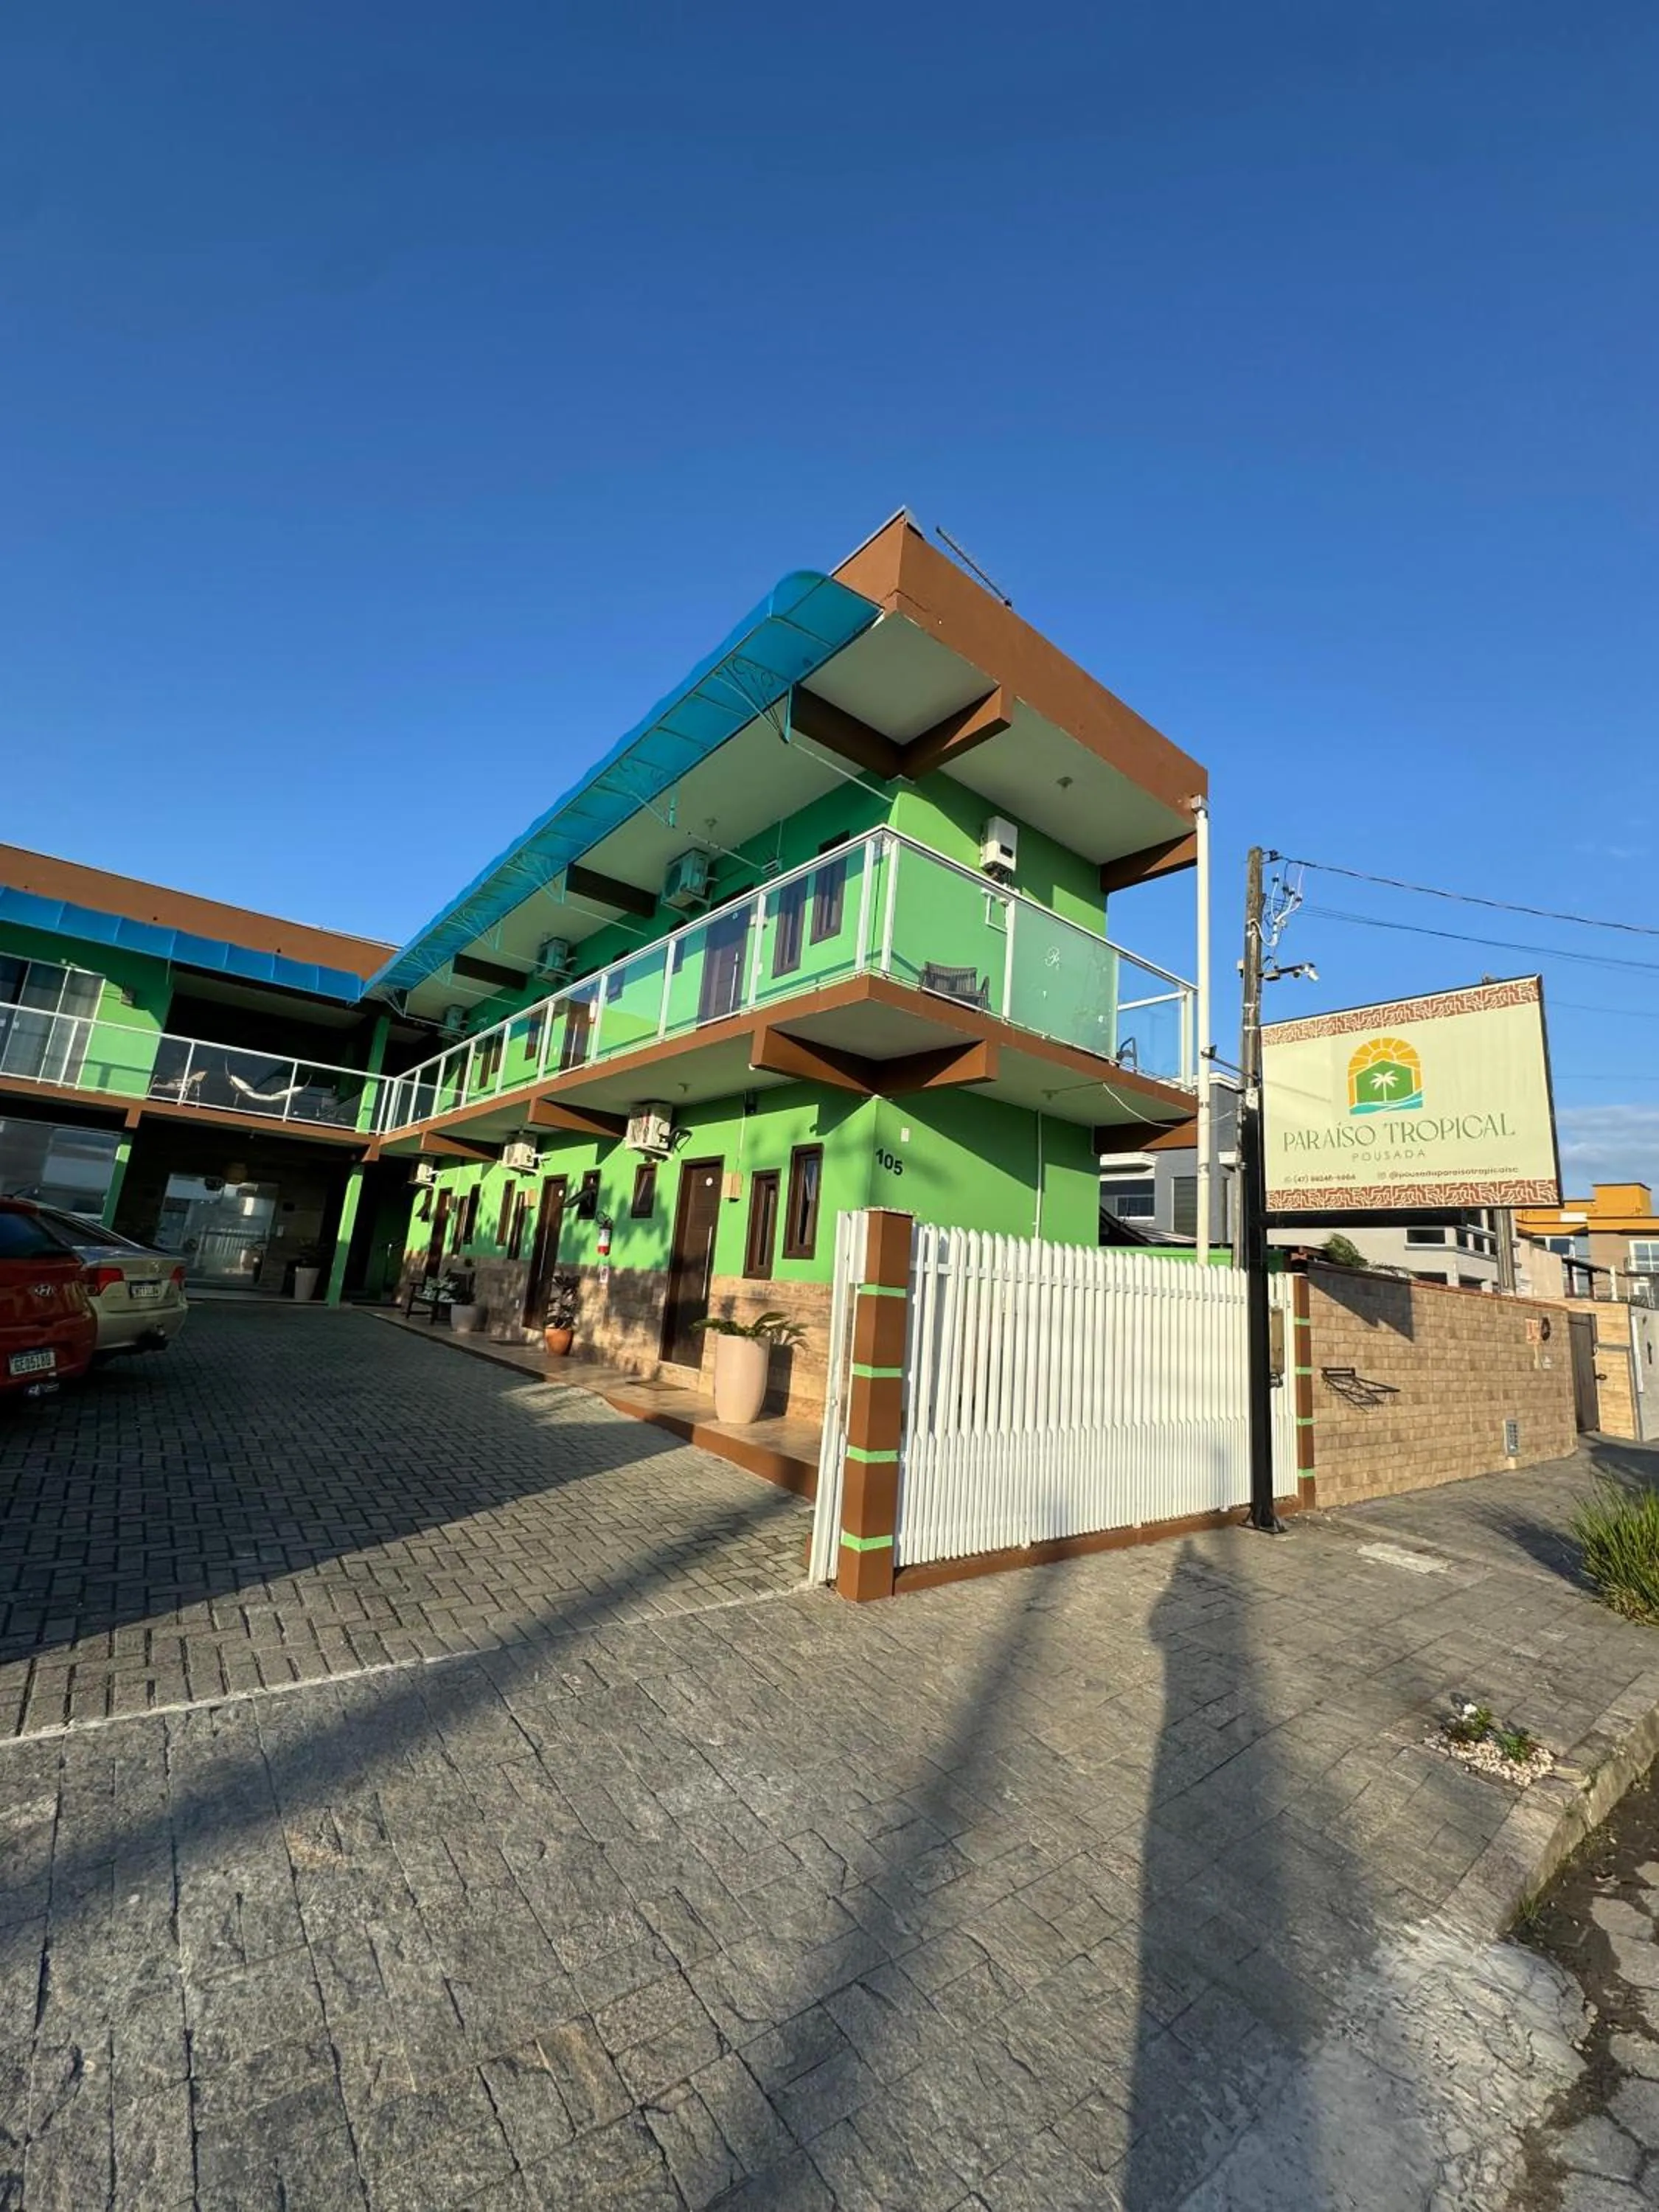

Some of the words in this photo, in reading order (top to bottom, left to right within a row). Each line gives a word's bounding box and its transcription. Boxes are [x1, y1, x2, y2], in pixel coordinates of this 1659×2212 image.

[1284, 1121, 1376, 1152] PARAÍSO
[1383, 1113, 1516, 1144] TROPICAL
[875, 1148, 903, 1175] 105
[1352, 1149, 1425, 1162] POUSADA
